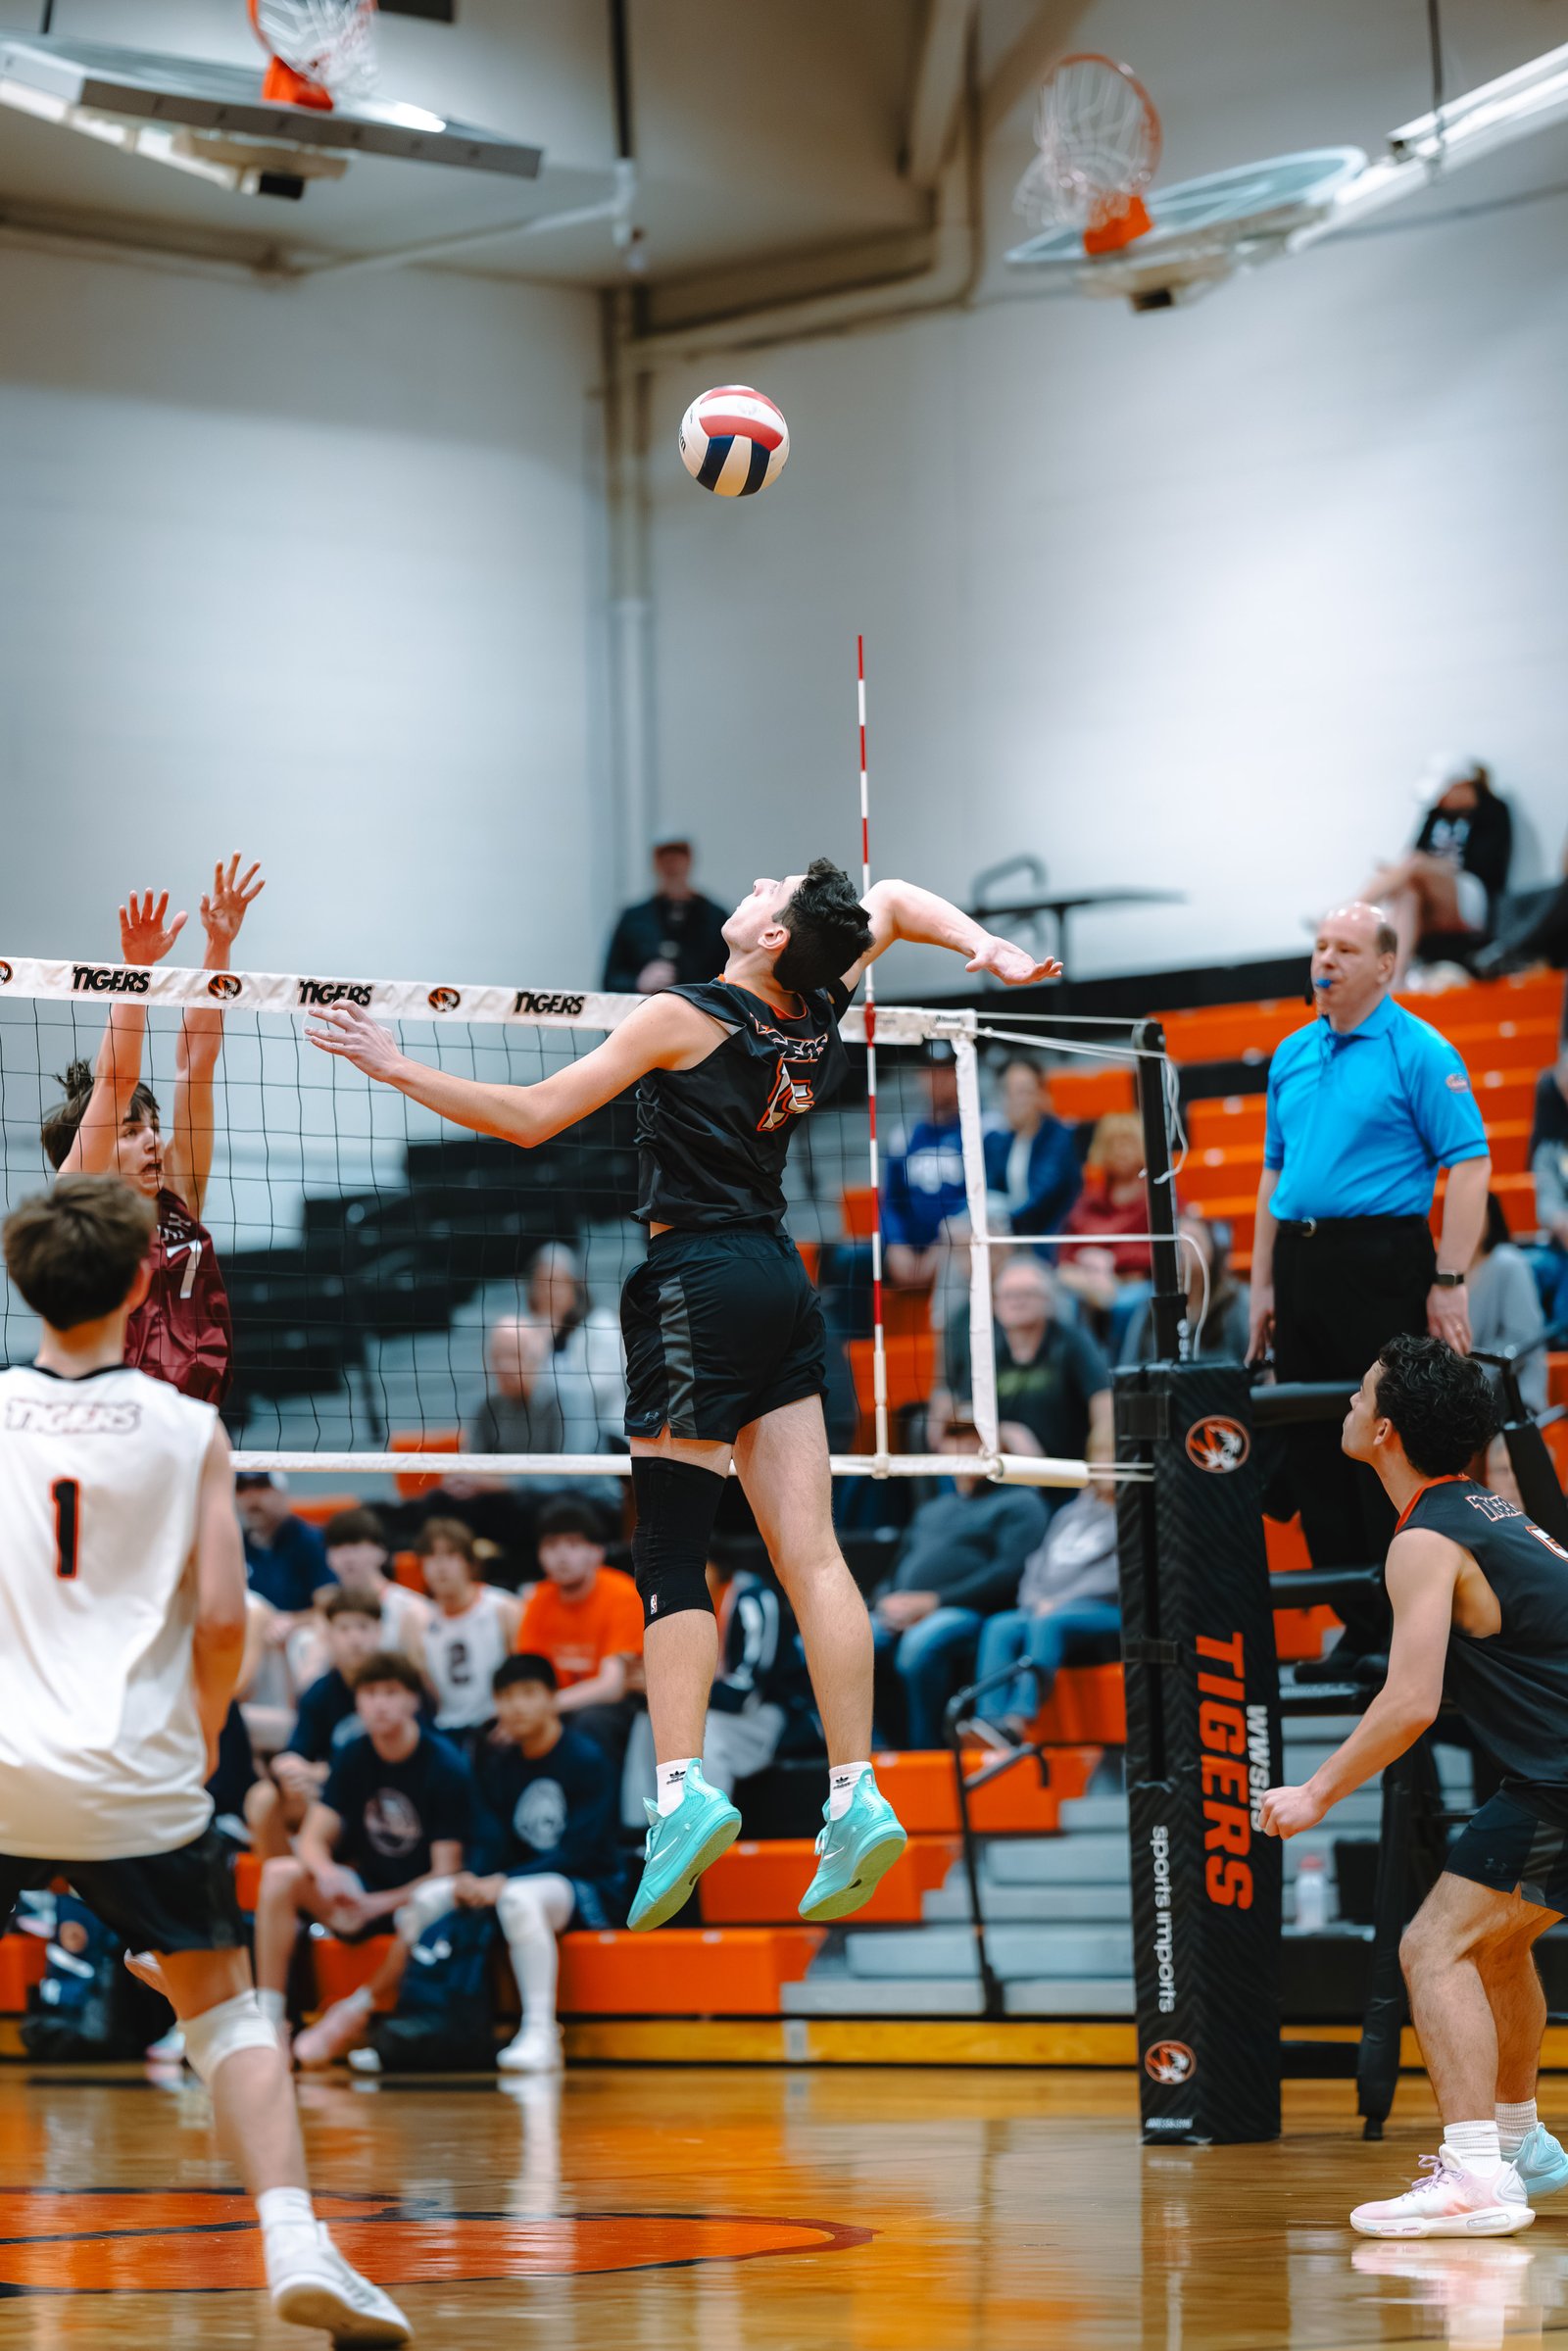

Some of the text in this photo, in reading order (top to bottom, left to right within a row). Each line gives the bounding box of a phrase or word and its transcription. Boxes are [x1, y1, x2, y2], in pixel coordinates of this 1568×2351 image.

[72, 965, 152, 995] TIGERS
[298, 979, 373, 1007] TIGERS
[514, 991, 585, 1016] TIGERS
[51, 1478, 79, 1580] 1
[1196, 1631, 1253, 1910] TIGERS
[1151, 1826, 1176, 2013] sports imports
